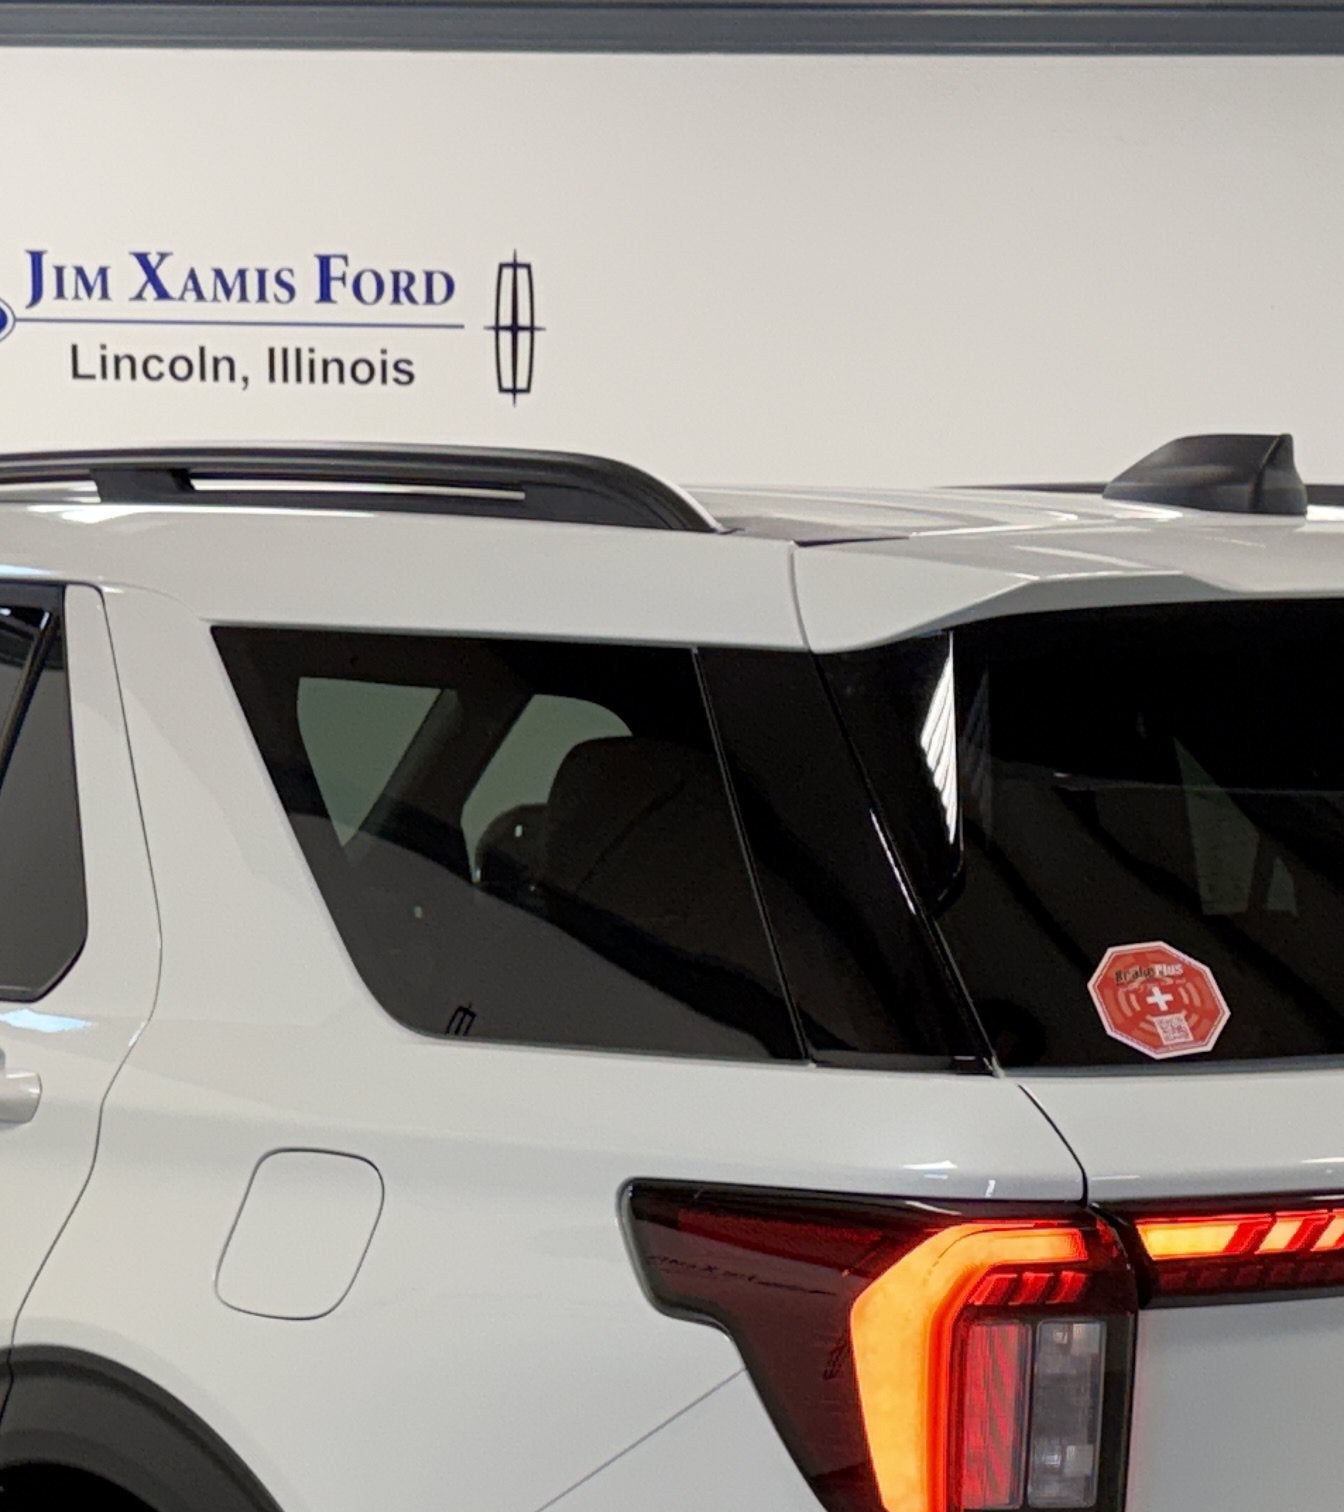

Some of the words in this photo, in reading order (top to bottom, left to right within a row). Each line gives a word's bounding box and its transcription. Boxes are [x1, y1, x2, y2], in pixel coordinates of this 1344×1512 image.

[25, 249, 112, 309] JIM
[129, 251, 297, 305] XAMIS
[314, 253, 456, 306] FORD
[70, 343, 249, 390] Lincoln,
[267, 346, 416, 386] Illinois
